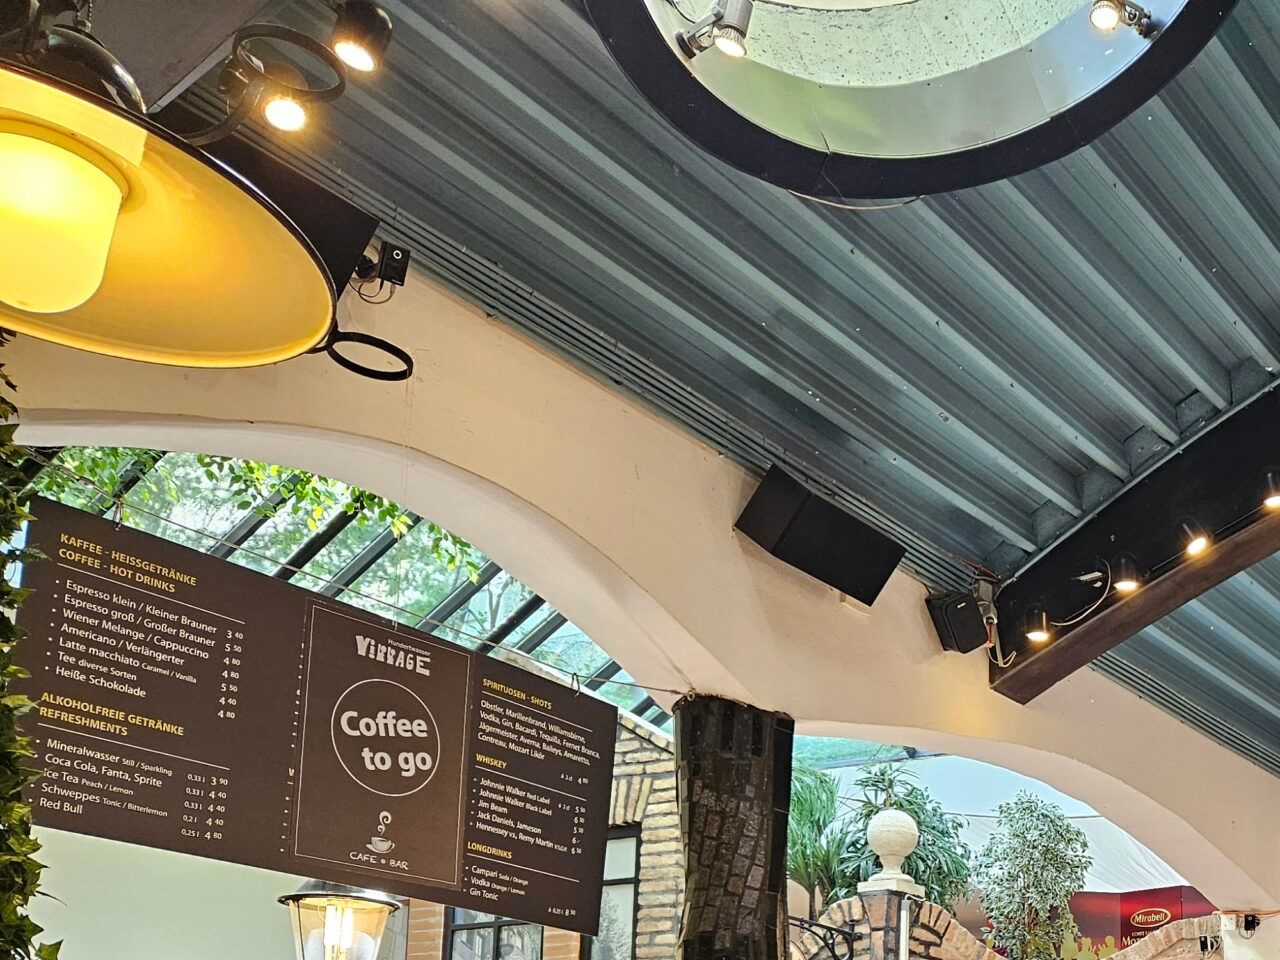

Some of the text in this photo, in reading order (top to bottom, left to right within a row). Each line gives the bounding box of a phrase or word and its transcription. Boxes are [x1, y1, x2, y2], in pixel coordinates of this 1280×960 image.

[59, 548, 176, 593] COFFEE HOT DRINKS
[61, 533, 197, 586] KAFFEE HEISSGETRÄNKE
[64, 594, 108, 615] Espresso
[111, 609, 134, 623] groß
[144, 618, 177, 636] Großer
[179, 630, 216, 647] Brauner
[66, 580, 110, 601] Espresso
[112, 594, 136, 609] klein
[145, 605, 179, 622] Kleiner
[181, 616, 218, 633] Brauner
[61, 623, 116, 646] Americano
[126, 641, 184, 665] Verlängerter
[63, 608, 99, 626] Wiener
[102, 620, 145, 641] Melange
[154, 635, 209, 659] Cappuccino
[58, 651, 76, 664] Tee
[79, 659, 108, 672] diverse
[110, 668, 137, 681] Sorten
[59, 637, 86, 653] Latte
[89, 646, 139, 667] macchiato
[141, 662, 170, 676] Caramel
[175, 671, 197, 683] Vanilla
[56, 665, 86, 681] Heiße
[89, 675, 147, 698] Schokolade
[483, 679, 552, 709] SPIRITUOSEN SHOTS
[40, 707, 128, 736] REFRESHMENTS
[41, 692, 184, 736] ALKOHOLFREIE GETRÄNKE
[340, 711, 428, 738] Coffee
[47, 739, 120, 763] Mineralwasser
[362, 748, 432, 777] to go
[476, 754, 507, 769] WHISKEY
[45, 754, 163, 787] Coca Cola, Fanta, Sprite
[62, 772, 79, 783] Tea
[81, 778, 102, 789] Peach
[109, 785, 134, 795] Lemon
[40, 798, 83, 814] Red Bull
[42, 783, 168, 817] Schweppes Tonic Bitterlemon
[349, 851, 408, 870] CAFE BAR
[468, 842, 512, 859] LONGDRINKS
[471, 877, 490, 887] Vodka
[472, 866, 497, 878] Campari
[470, 888, 498, 900] Gin Tonic
[1134, 913, 1165, 923] Mirabell
